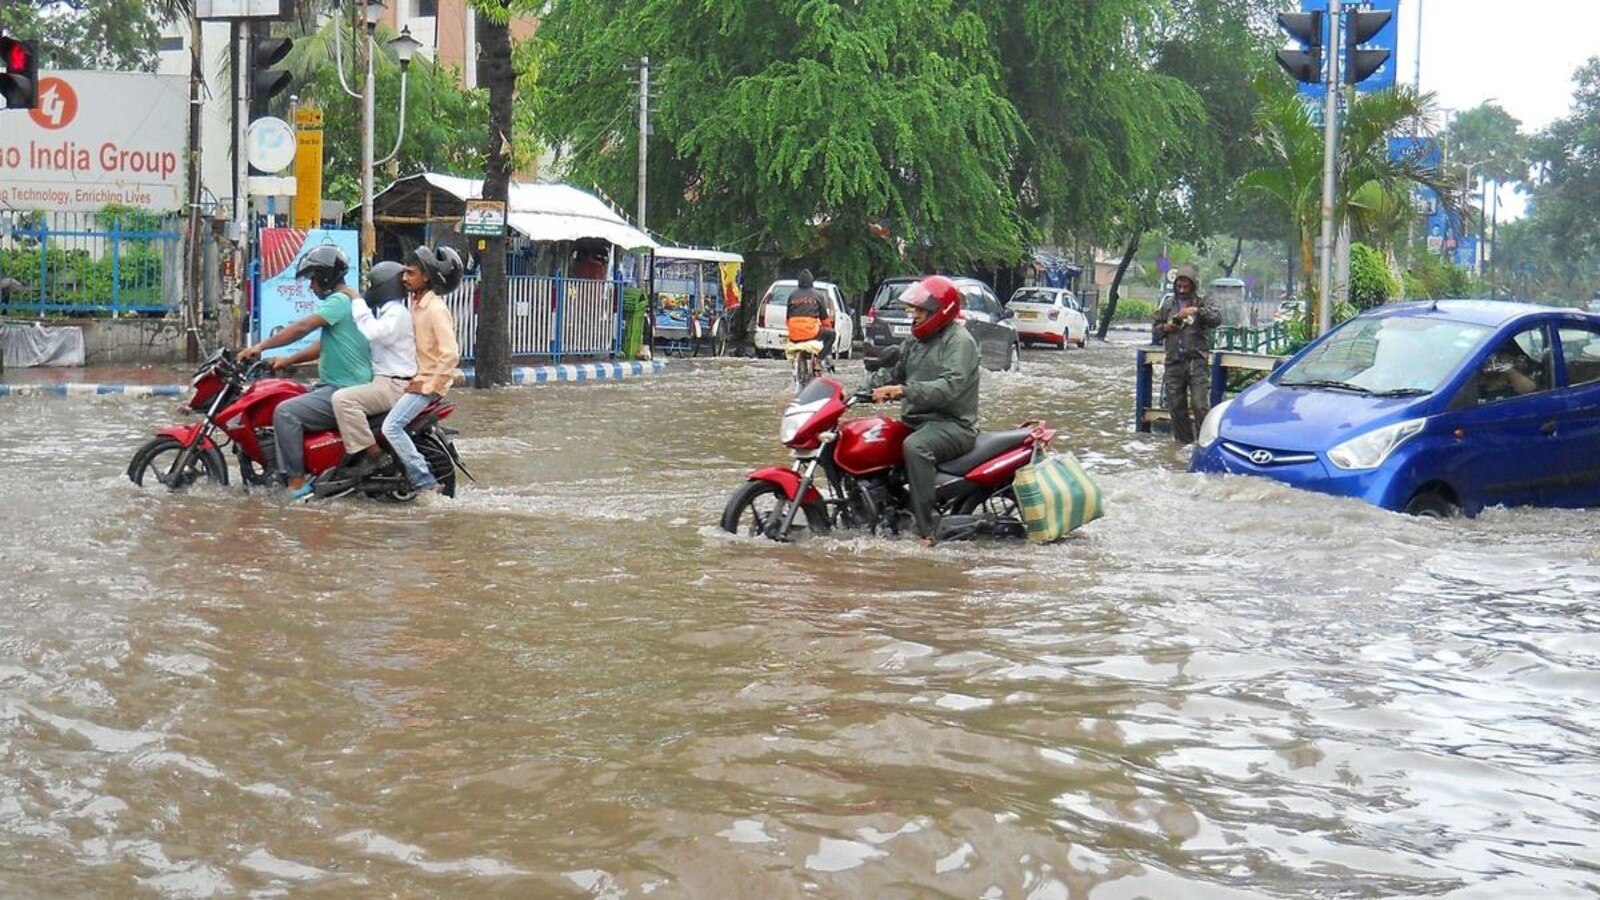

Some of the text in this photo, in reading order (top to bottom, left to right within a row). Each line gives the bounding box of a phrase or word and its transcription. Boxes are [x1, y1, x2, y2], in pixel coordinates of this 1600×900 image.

[30, 141, 90, 171] India
[100, 143, 176, 180] Group
[75, 189, 122, 204] Enriching
[125, 191, 151, 204] Lives
